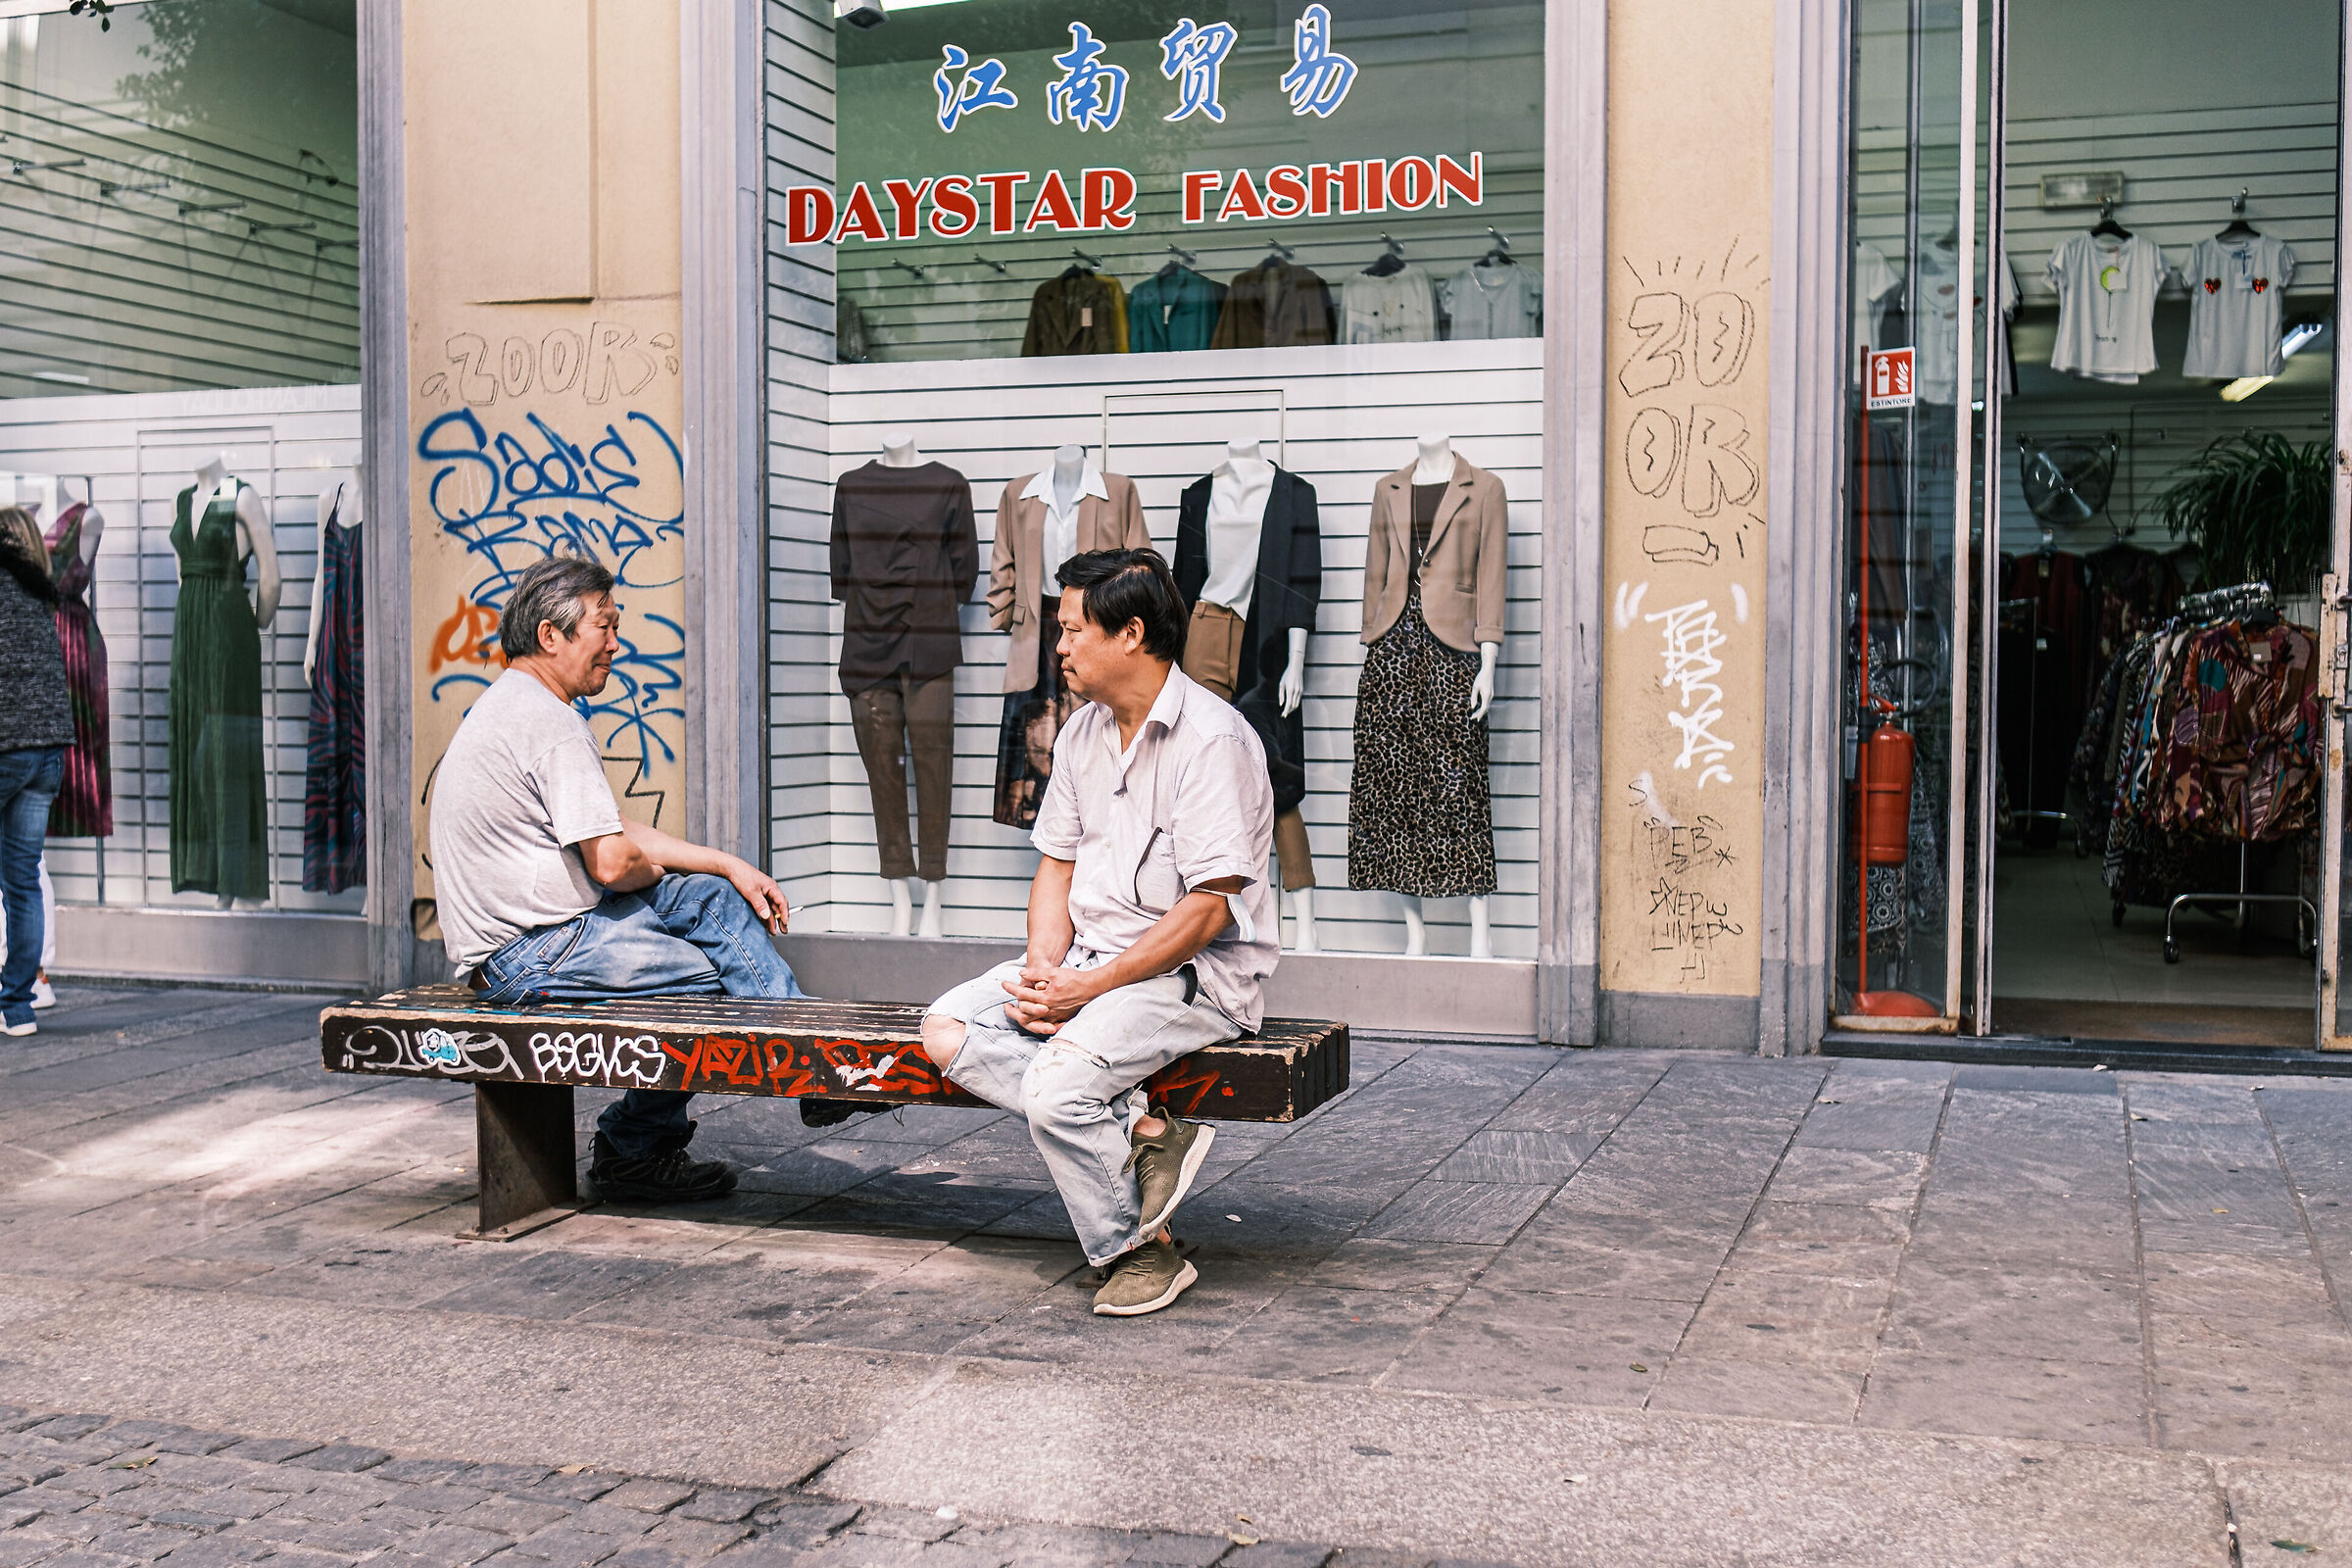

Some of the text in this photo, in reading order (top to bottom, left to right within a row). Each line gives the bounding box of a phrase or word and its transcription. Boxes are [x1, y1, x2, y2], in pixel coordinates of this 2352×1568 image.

[932, 3, 1358, 133] 江南贸易
[785, 151, 1484, 248] DAYSTAR FASHION
[1870, 397, 1912, 408] ESTINTORE
